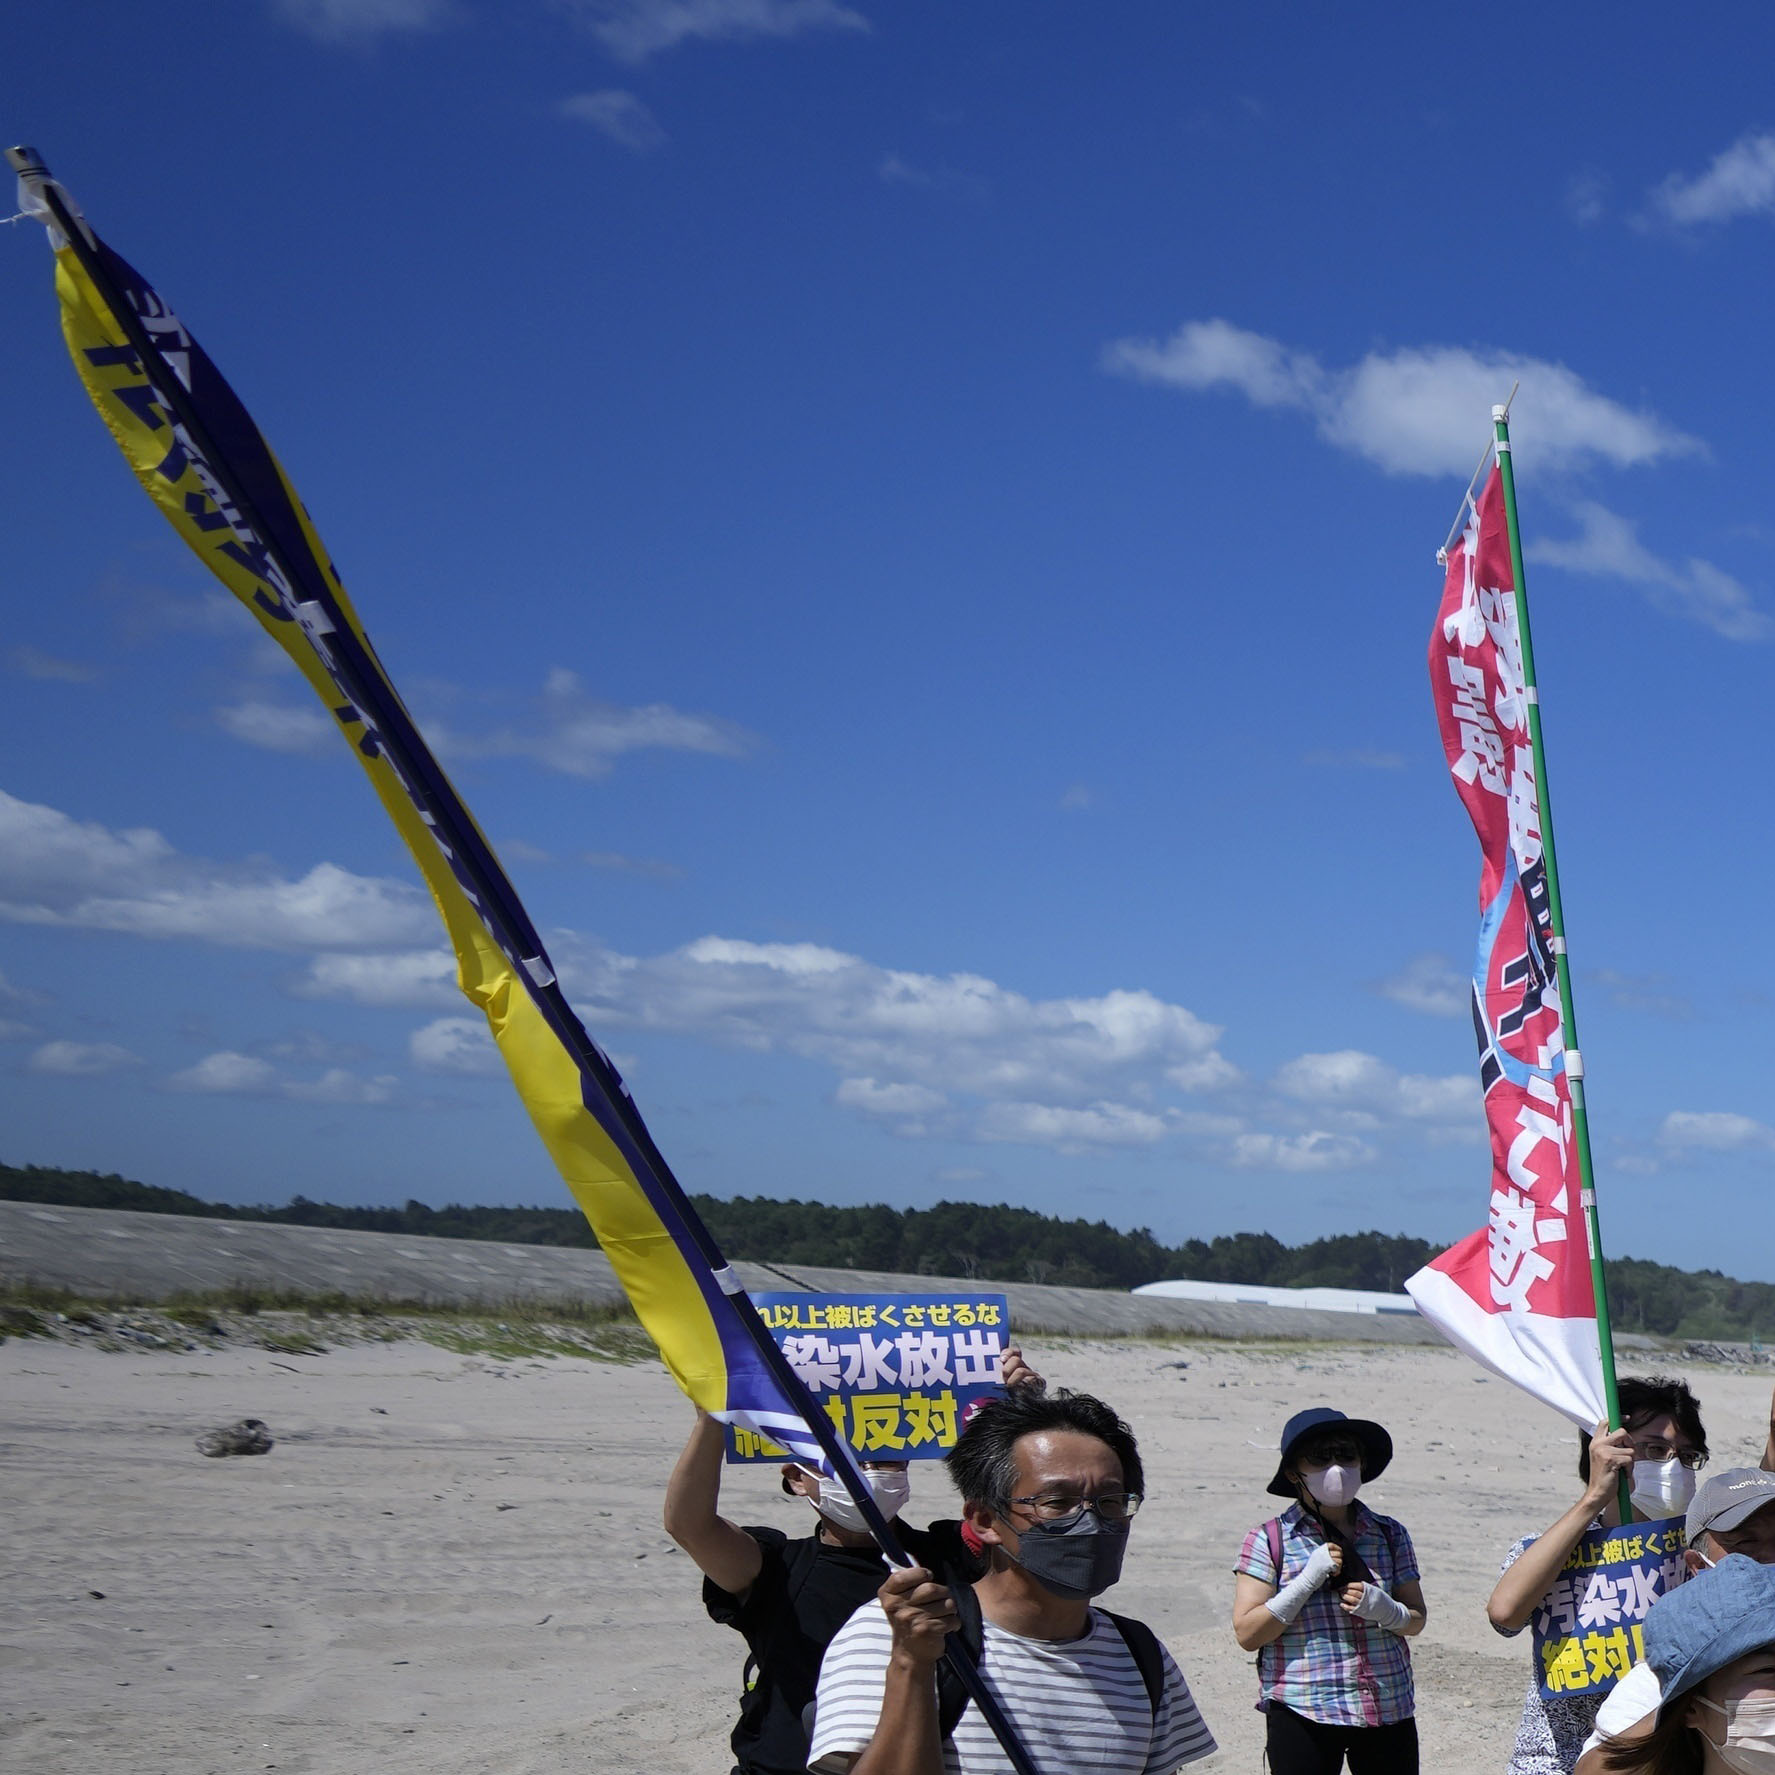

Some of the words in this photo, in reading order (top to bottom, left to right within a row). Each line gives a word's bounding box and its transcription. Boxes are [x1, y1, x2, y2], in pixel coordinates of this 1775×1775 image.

[757, 1304, 1001, 1330] れ以上被ばくさせるな
[774, 1330, 1005, 1392] 染水放出
[1542, 1624, 1645, 1692] 絶対
